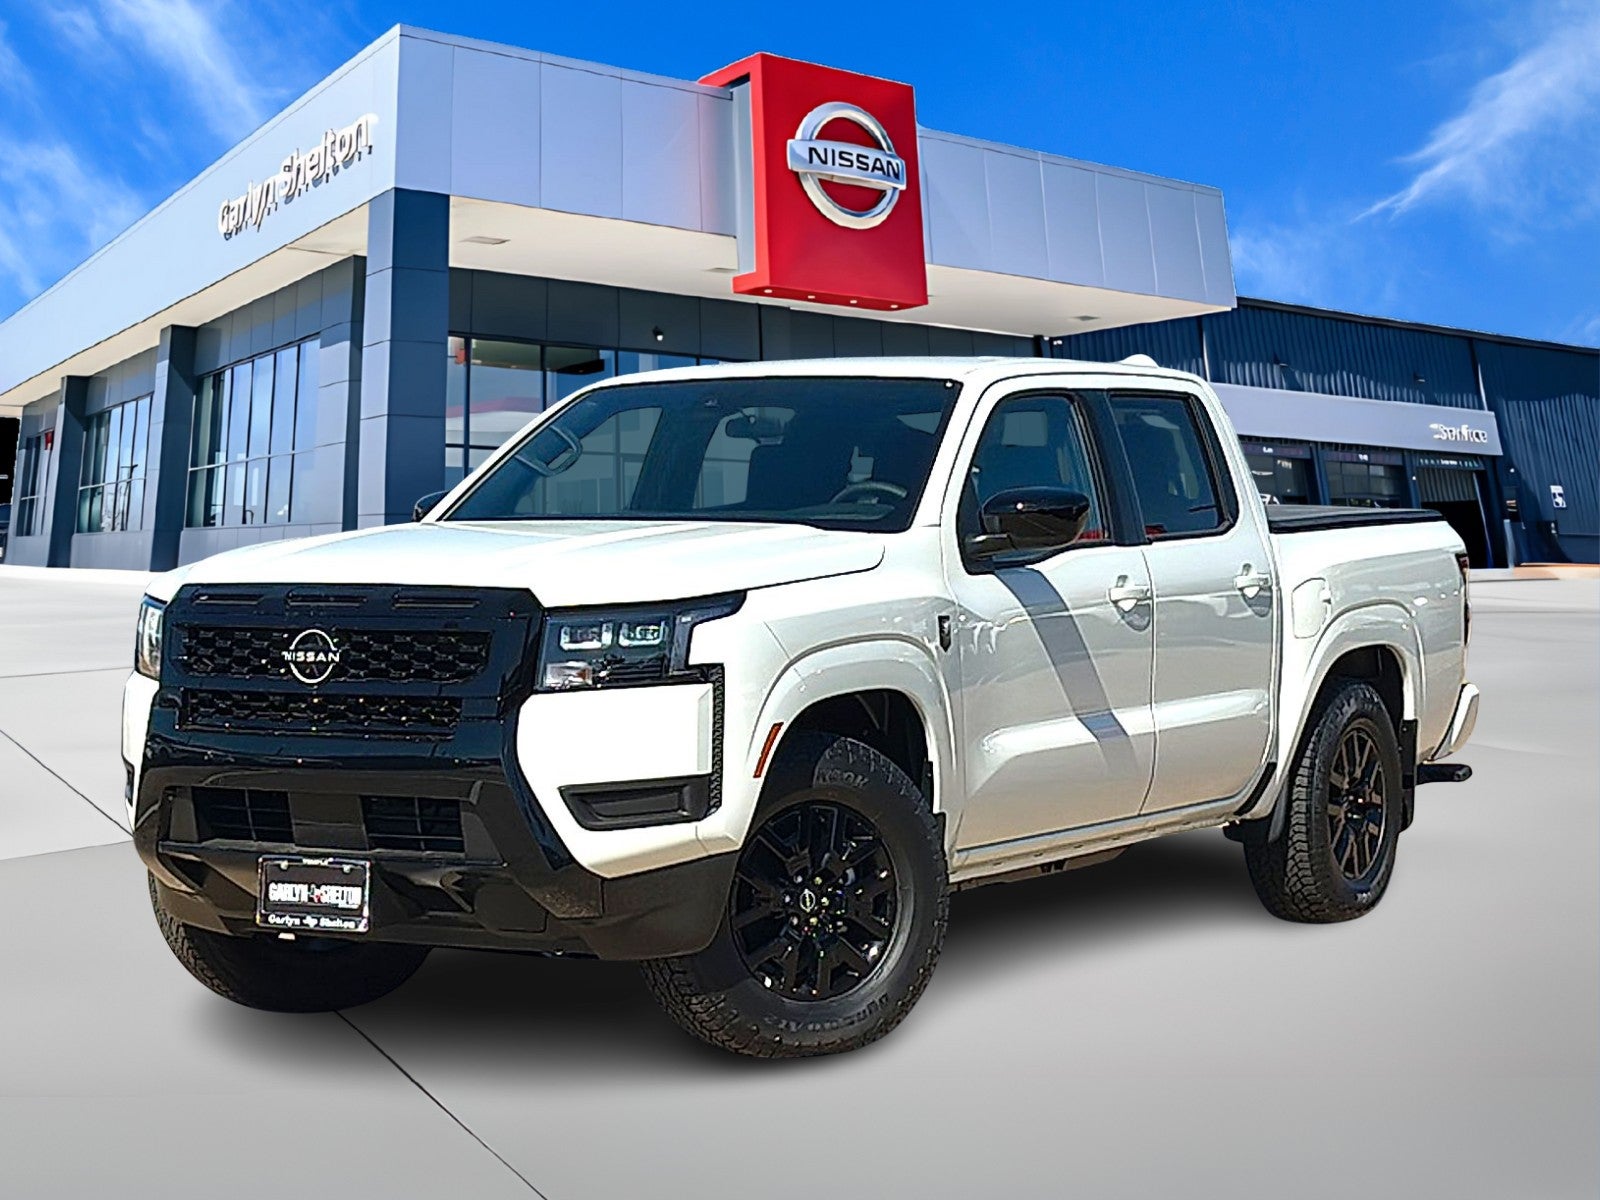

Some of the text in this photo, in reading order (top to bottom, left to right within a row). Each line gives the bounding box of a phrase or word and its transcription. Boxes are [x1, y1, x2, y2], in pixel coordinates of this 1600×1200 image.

[279, 114, 374, 203] Shelton
[808, 146, 900, 179] NISSAN
[281, 651, 340, 662] NISSAN
